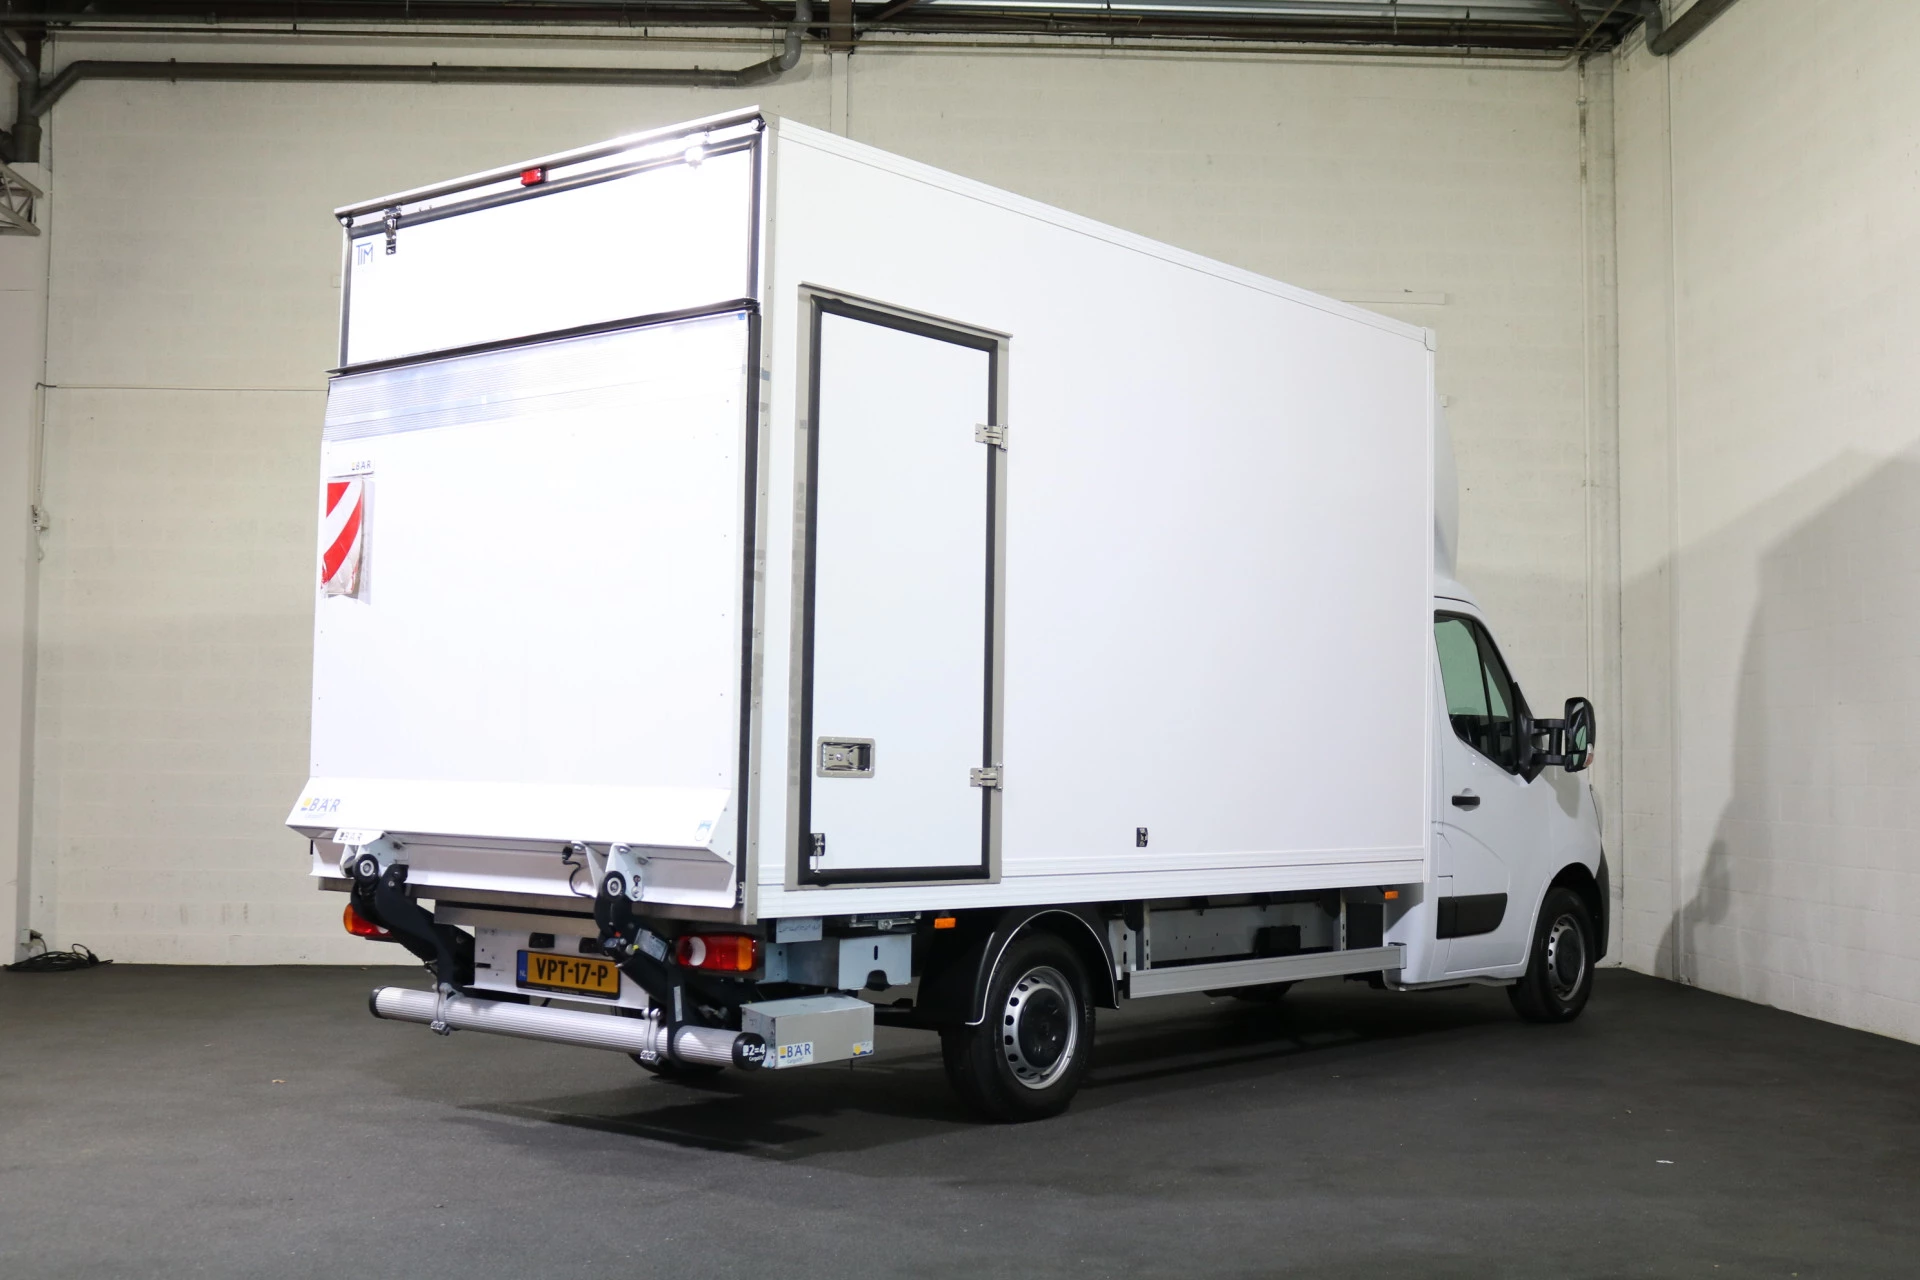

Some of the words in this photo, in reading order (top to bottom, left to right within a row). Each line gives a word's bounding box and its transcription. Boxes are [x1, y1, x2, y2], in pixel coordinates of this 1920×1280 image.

[519, 969, 527, 977] NL
[536, 957, 608, 987] VPT-17-P
[787, 1043, 812, 1058] BÄR
